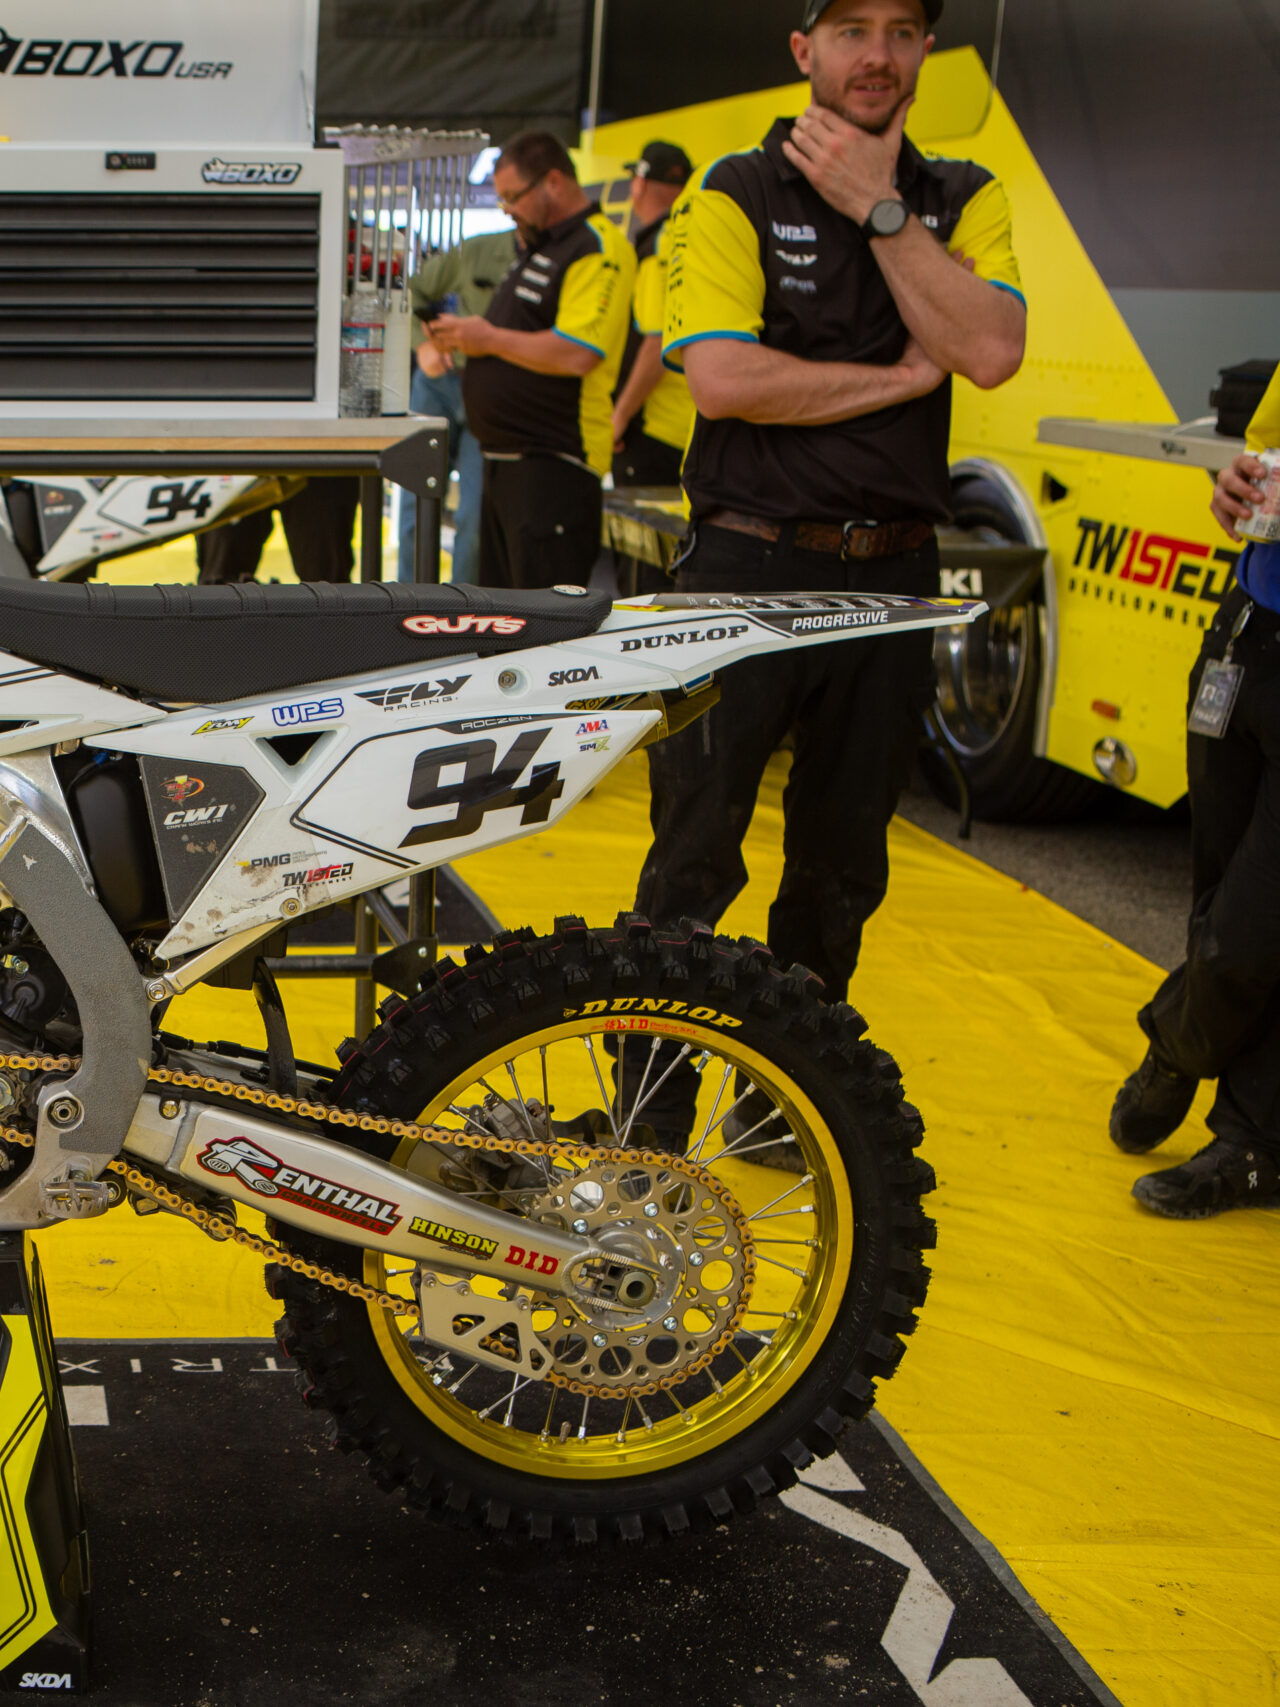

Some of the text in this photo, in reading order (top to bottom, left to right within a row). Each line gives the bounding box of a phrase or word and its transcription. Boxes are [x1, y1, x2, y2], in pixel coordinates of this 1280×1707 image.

[12, 39, 234, 79] BOXO USA
[220, 163, 301, 184] BOXO
[144, 479, 213, 526] 94
[1073, 516, 1242, 604] TWISTED
[1068, 577, 1207, 628] DEVELOPMEN
[402, 614, 527, 635] GUTS
[791, 610, 889, 631] PROGRESSIVE
[620, 624, 749, 652] DUNLOP
[354, 674, 473, 706] FLY
[547, 665, 600, 687] SKDA
[272, 698, 344, 727] WPS
[383, 697, 455, 712] RACING
[460, 714, 533, 731] ROCZEN
[575, 719, 609, 735] AMA
[397, 727, 566, 848] 94
[251, 853, 291, 867] PMG
[282, 863, 354, 887] TWISTED
[578, 997, 743, 1028] DUNLOP
[203, 1138, 399, 1226] RENTHAL
[282, 1189, 389, 1235] CHAINWHEELS
[410, 1217, 499, 1254] HINSON
[18, 1672, 73, 1689] SKDA
